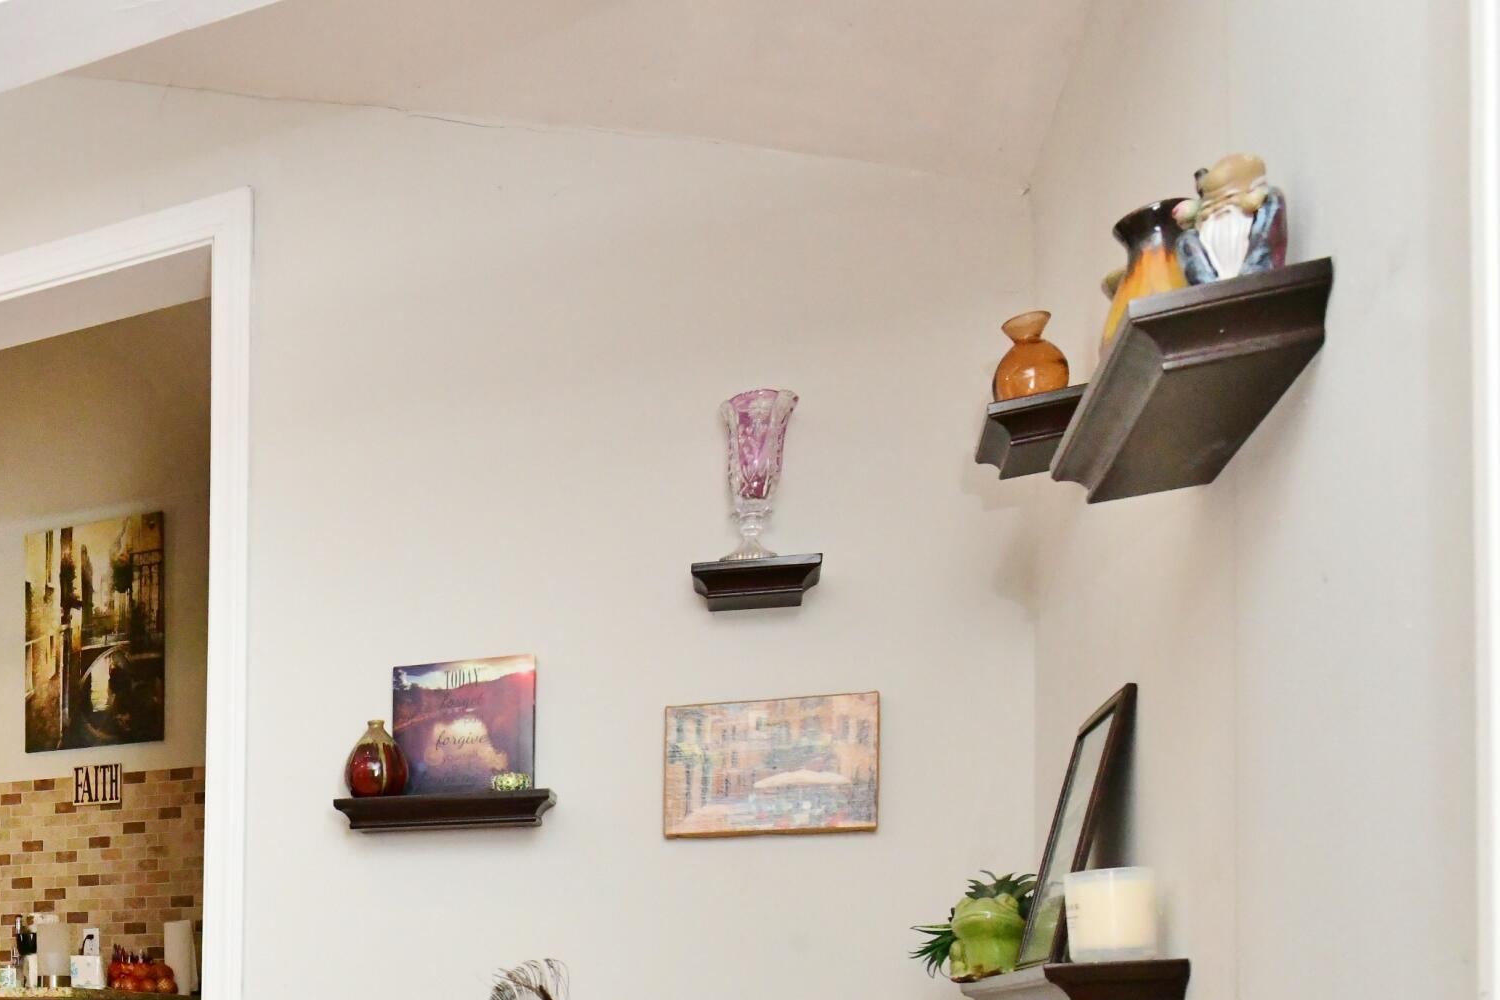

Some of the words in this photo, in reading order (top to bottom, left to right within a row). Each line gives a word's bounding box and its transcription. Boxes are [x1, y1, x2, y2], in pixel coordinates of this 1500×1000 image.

[444, 668, 479, 688] TODAY
[436, 730, 488, 751] forgive
[74, 764, 119, 803] FAITH
